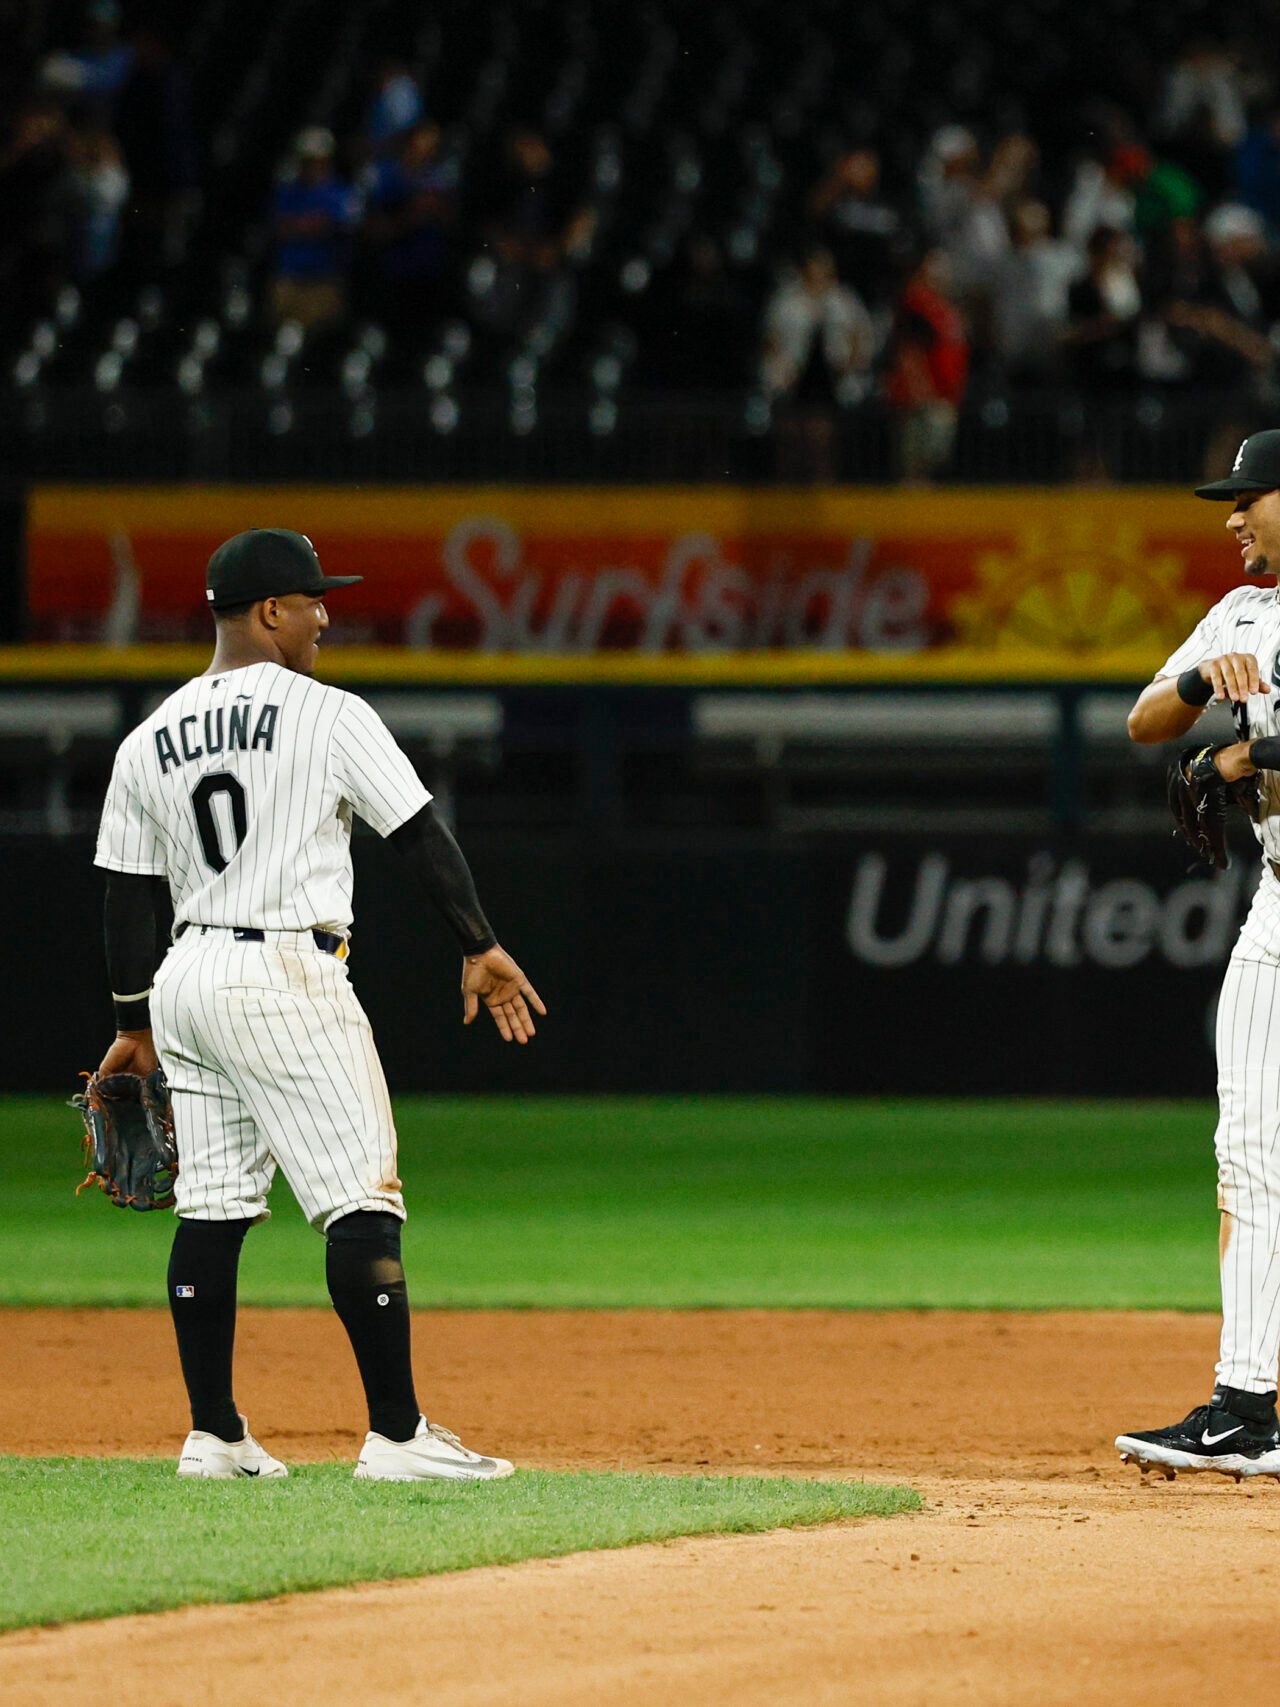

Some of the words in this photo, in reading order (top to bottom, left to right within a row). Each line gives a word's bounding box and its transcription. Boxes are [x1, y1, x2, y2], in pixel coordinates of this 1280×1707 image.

[408, 515, 930, 656] Surfside
[155, 695, 279, 774] ACUÑA
[190, 770, 249, 875] 0
[846, 850, 1238, 968] United
